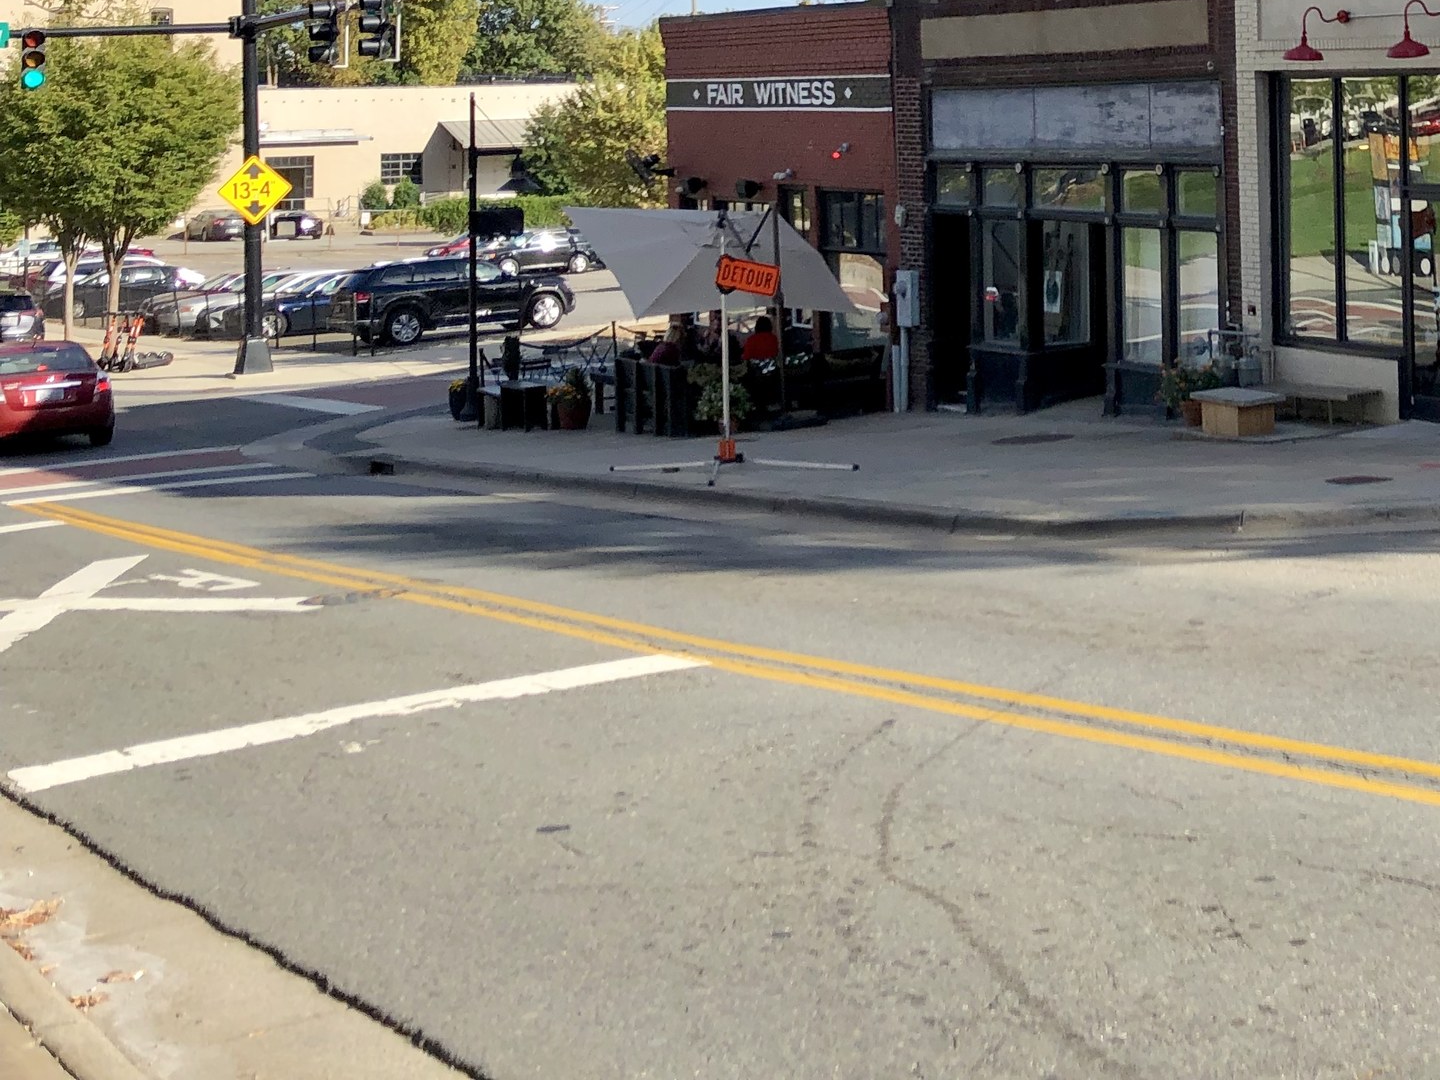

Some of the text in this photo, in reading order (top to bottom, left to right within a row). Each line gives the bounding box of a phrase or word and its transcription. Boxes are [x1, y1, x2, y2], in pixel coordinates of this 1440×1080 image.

[707, 81, 836, 105] FAIR WITNESS
[722, 264, 773, 289] DETOUR
